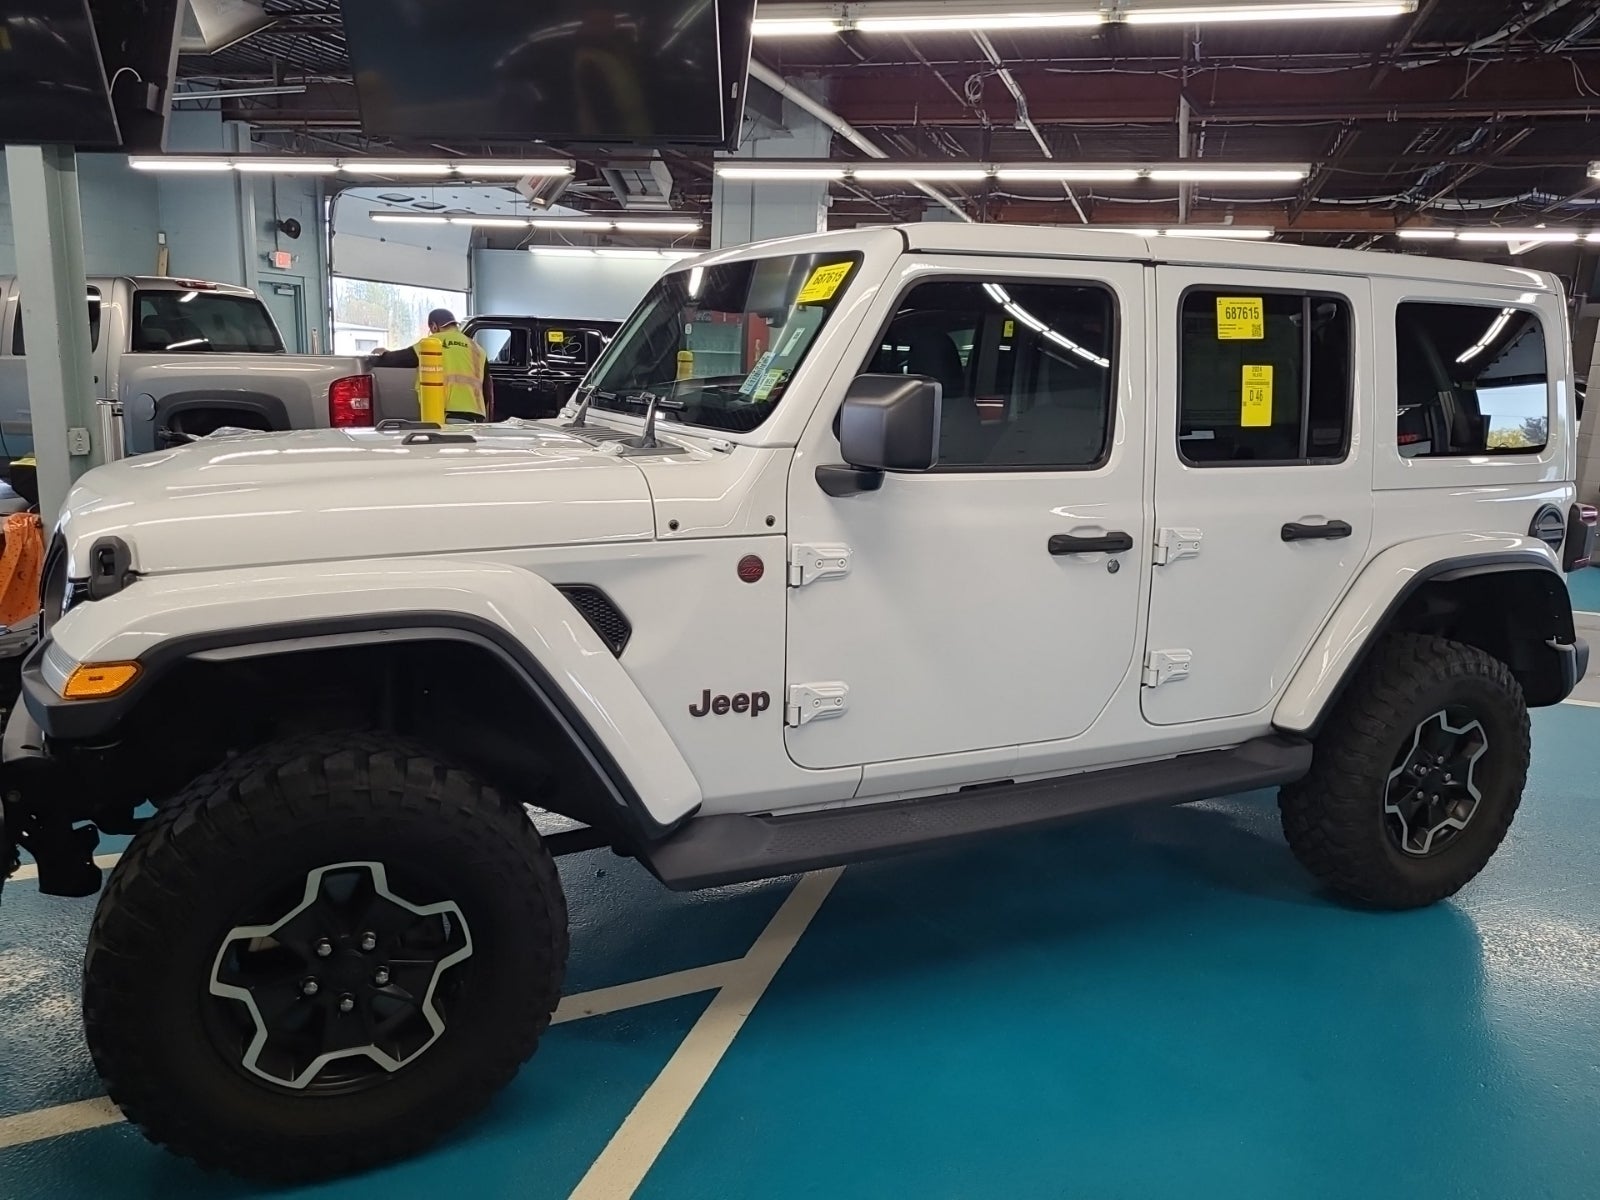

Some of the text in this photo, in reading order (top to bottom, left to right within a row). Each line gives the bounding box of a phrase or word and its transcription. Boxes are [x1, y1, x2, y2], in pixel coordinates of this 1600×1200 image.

[812, 271, 845, 285] 687615
[1225, 306, 1260, 320] 687615
[688, 689, 770, 717] Jeep
